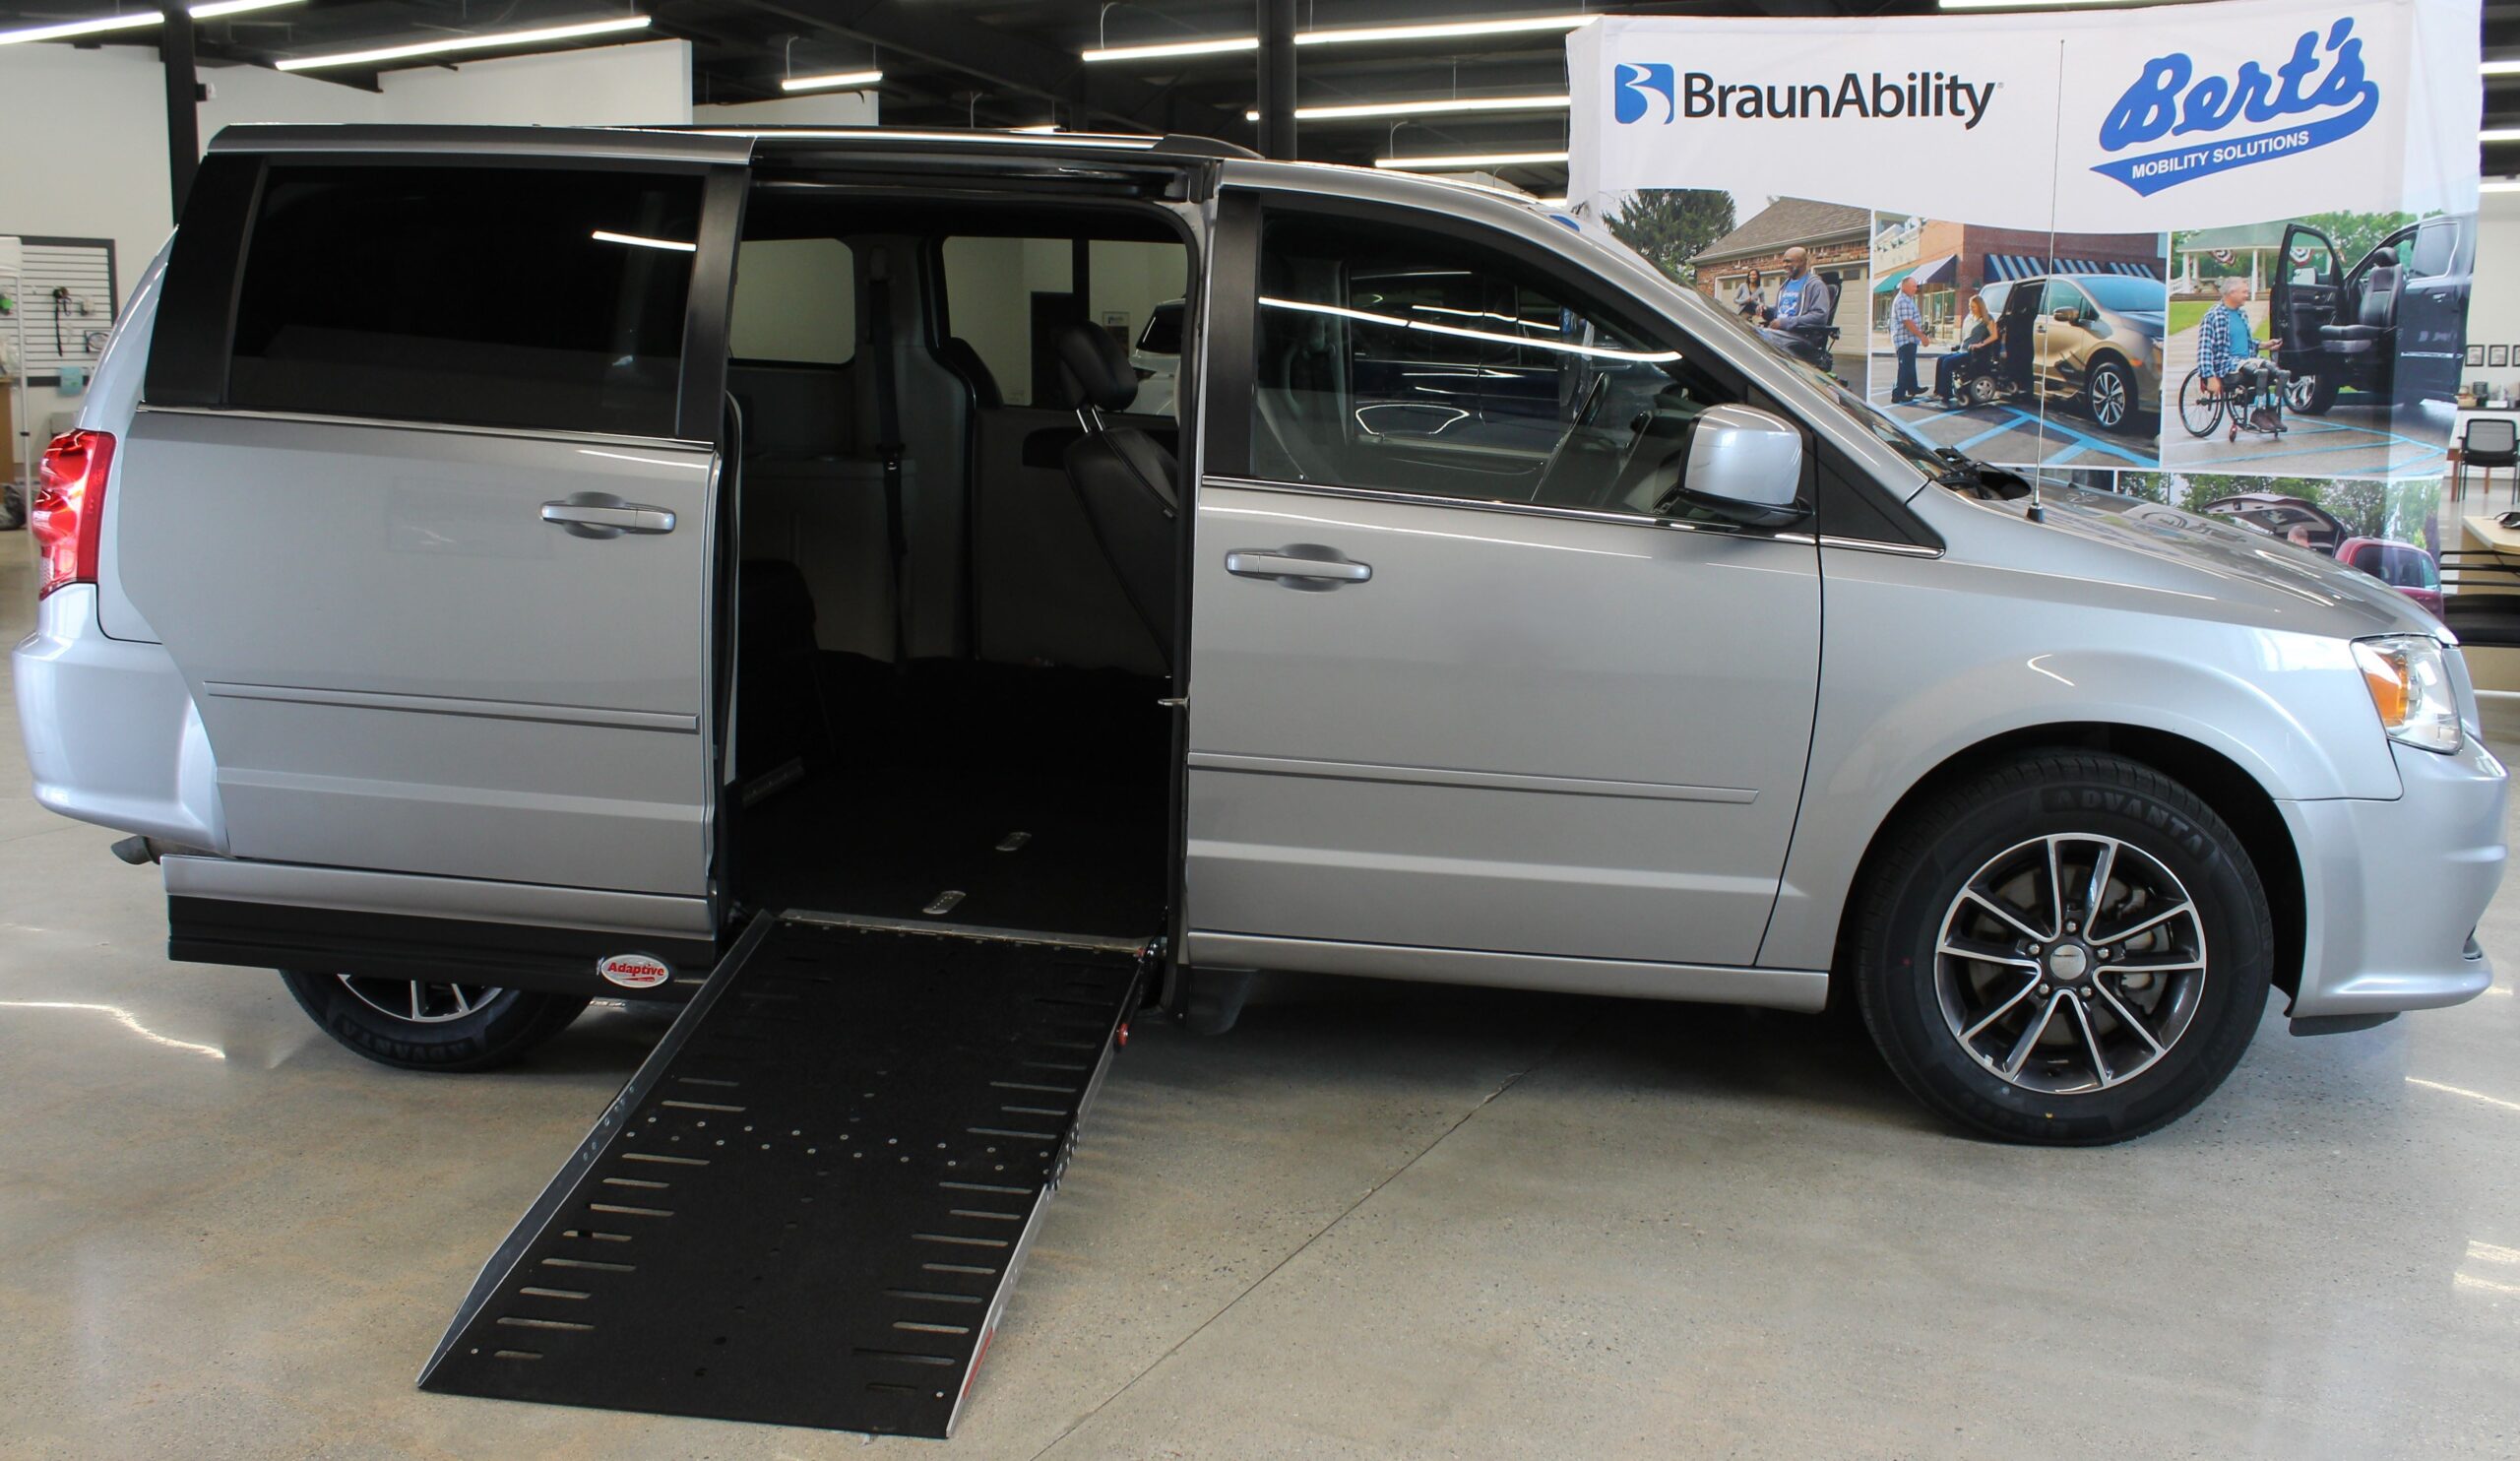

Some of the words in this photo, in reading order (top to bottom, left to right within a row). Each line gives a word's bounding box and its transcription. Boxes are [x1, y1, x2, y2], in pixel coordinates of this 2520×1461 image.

[1683, 71, 1996, 131] BraunAbility
[2099, 16, 2364, 152] Bert's
[2131, 151, 2208, 179] MOBILITY
[2212, 130, 2309, 162] SOLUTIONS
[2055, 790, 2203, 854] ADVANTA
[607, 962, 664, 977] Adaptive
